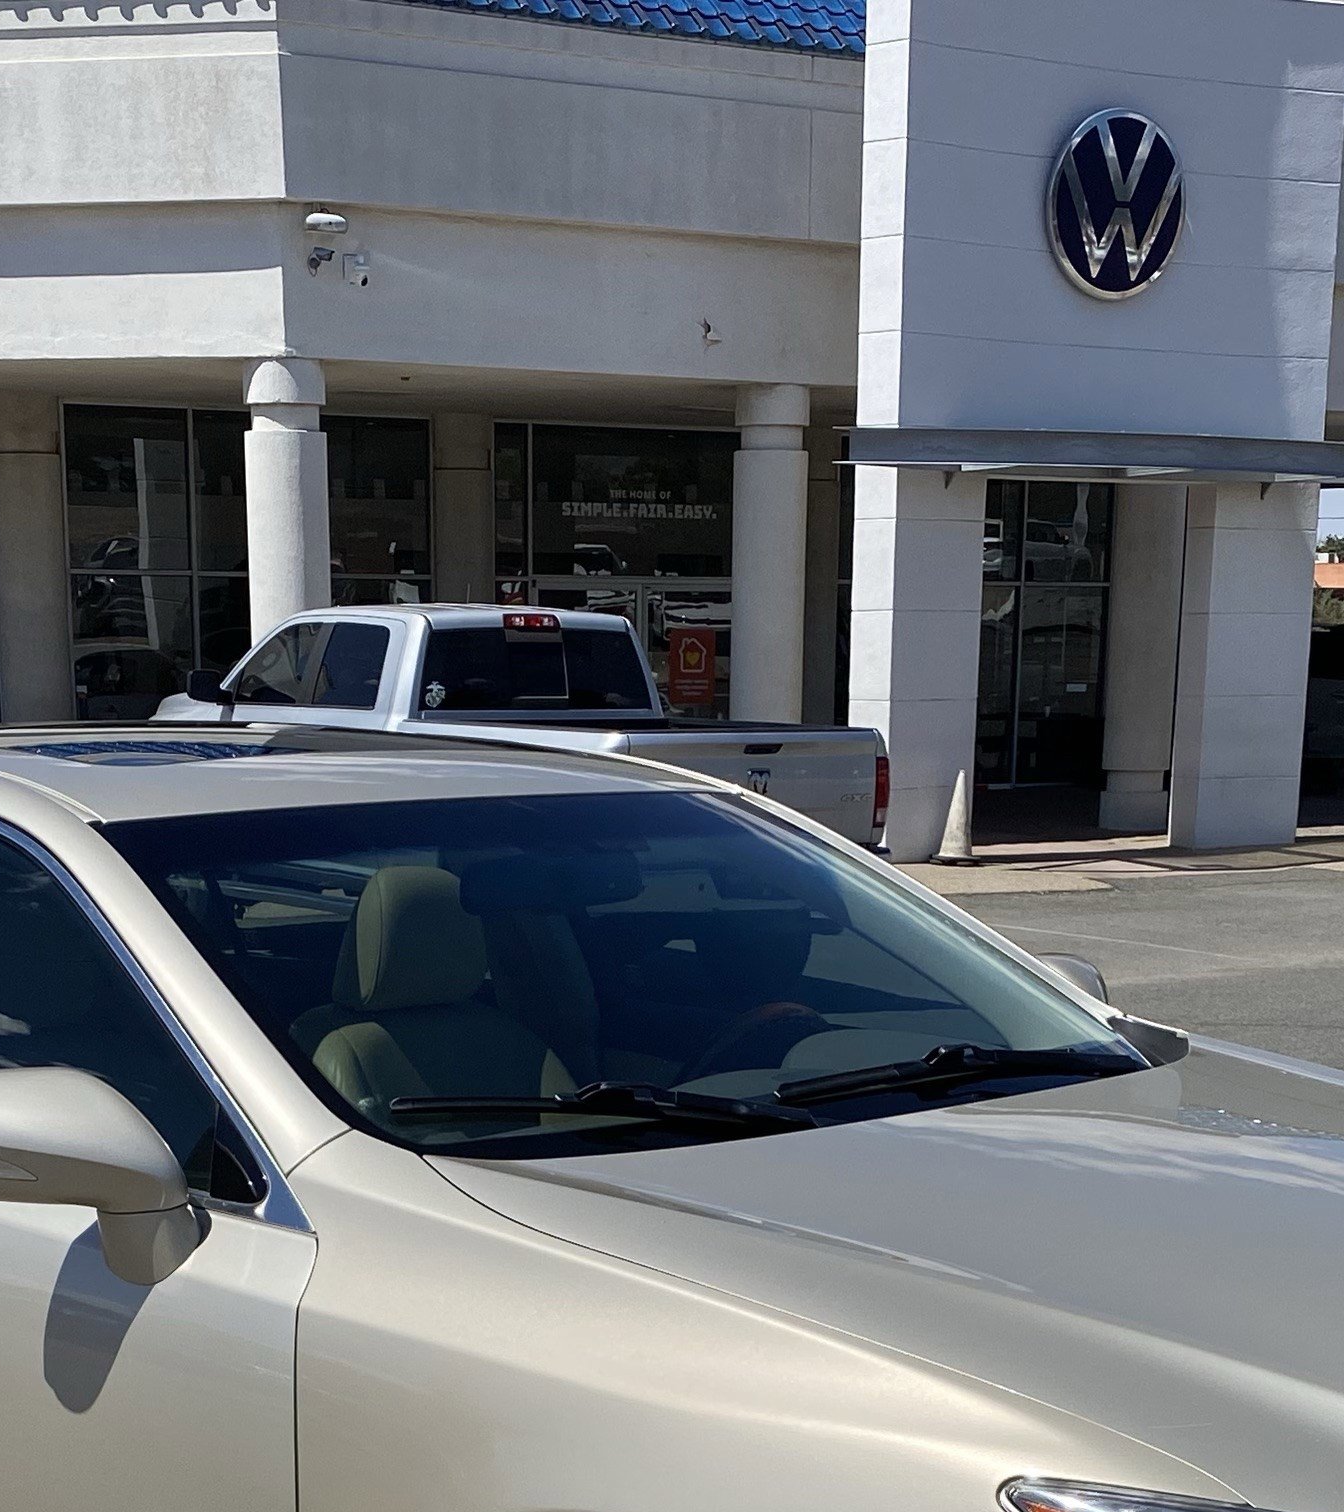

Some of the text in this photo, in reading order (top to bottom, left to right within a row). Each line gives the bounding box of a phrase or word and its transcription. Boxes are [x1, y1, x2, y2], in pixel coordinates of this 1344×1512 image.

[1058, 110, 1184, 285] VW
[609, 489, 672, 500] THE HOME OF
